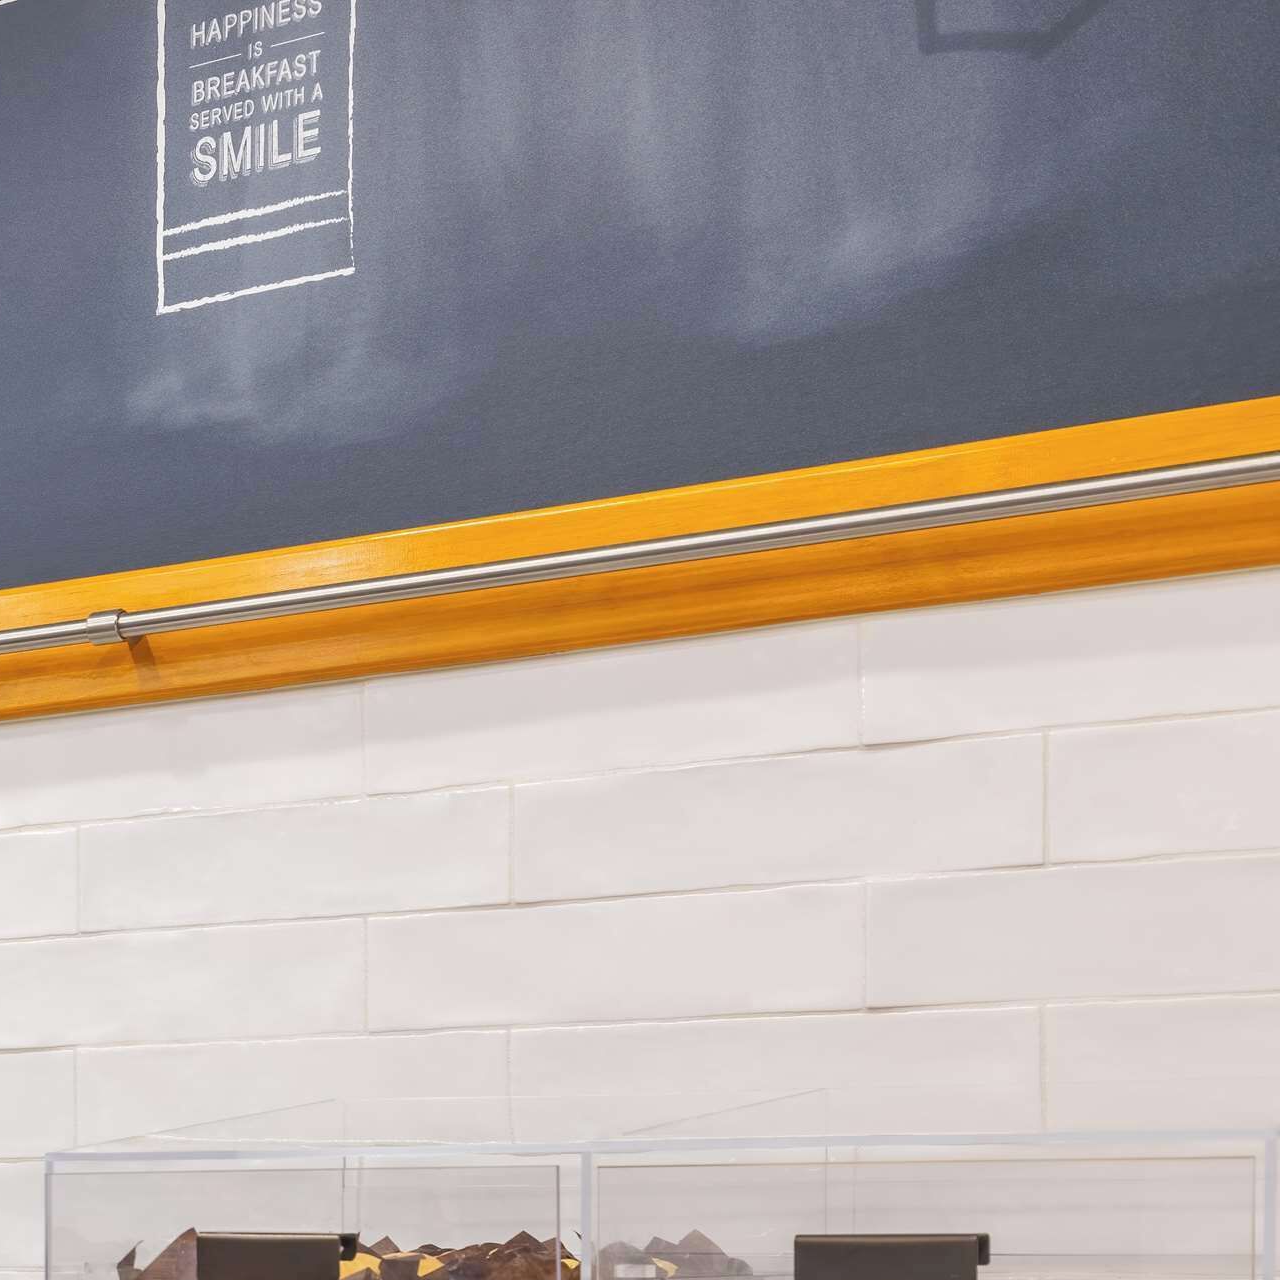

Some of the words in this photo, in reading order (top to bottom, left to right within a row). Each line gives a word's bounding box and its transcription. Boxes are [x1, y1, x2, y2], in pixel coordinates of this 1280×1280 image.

[192, 0, 322, 48] HAPPINESS
[248, 41, 263, 60] IS
[192, 50, 322, 106] BREAKFAST
[189, 99, 255, 131] SERVED
[262, 86, 305, 114] WITH
[311, 82, 324, 104] A
[191, 109, 322, 186] SMILE
